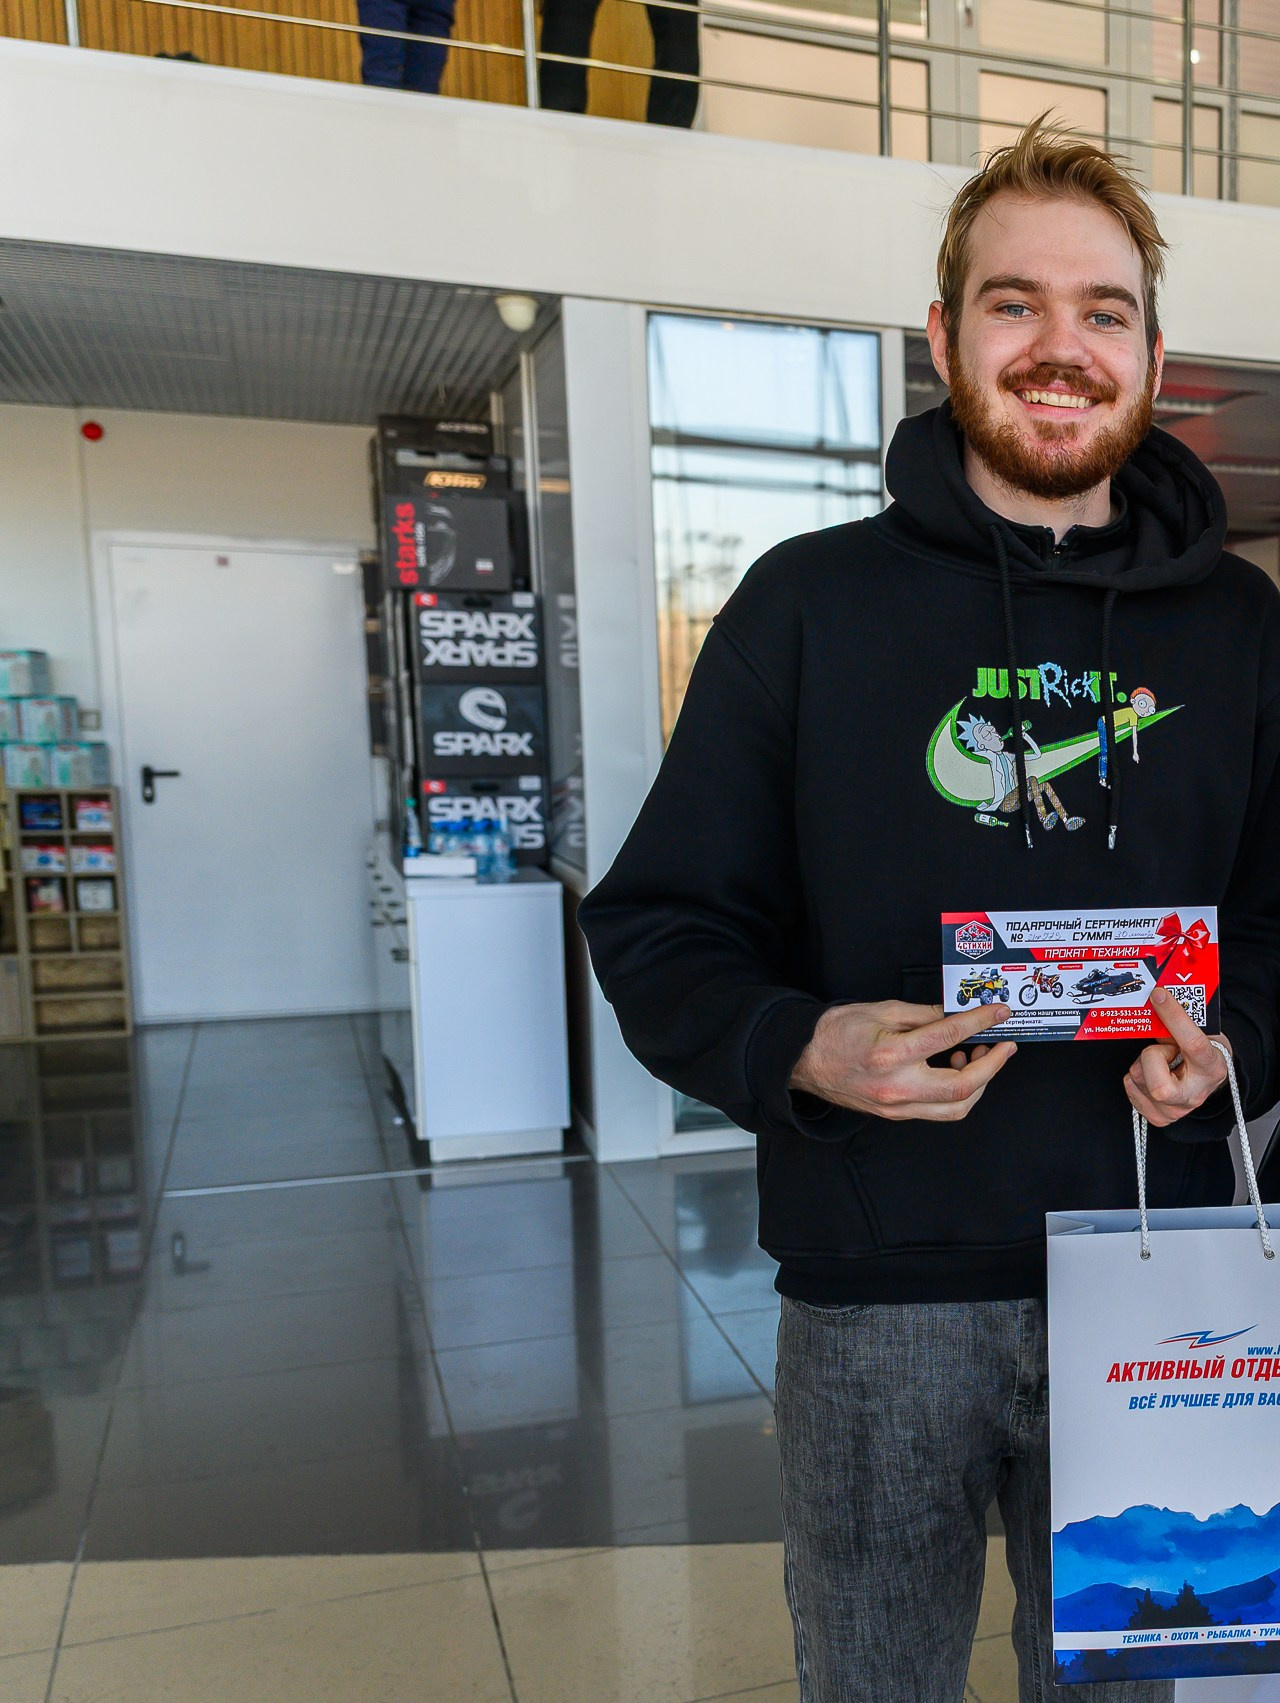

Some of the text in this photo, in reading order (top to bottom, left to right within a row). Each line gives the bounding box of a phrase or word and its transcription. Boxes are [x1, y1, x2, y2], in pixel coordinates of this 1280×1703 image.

[391, 502, 419, 585] starks
[419, 610, 537, 640] SPARX
[423, 639, 539, 668] SPARX
[433, 731, 534, 757] SPARX
[428, 796, 543, 824] SPARX
[1006, 918, 1158, 932] ПОДАРОЧНЫЙ СЕРТИФИКАТ
[1073, 931, 1113, 941] СУММА
[1044, 946, 1140, 959] ПРОКАТ ТЕХНИКИ
[1117, 1018, 1152, 1026] Кемерово,
[1106, 1355, 1226, 1383] АКТИВНЫЙ
[1128, 1393, 1158, 1410] ВСЁ
[1159, 1393, 1222, 1409] ЛУЧШЕЕ
[1222, 1393, 1255, 1409] ДЛЯ
[1122, 1633, 1162, 1644] ТЕХНИКА
[1170, 1631, 1199, 1641] ОХОТА
[1206, 1629, 1251, 1639] РЫБАЛКА
